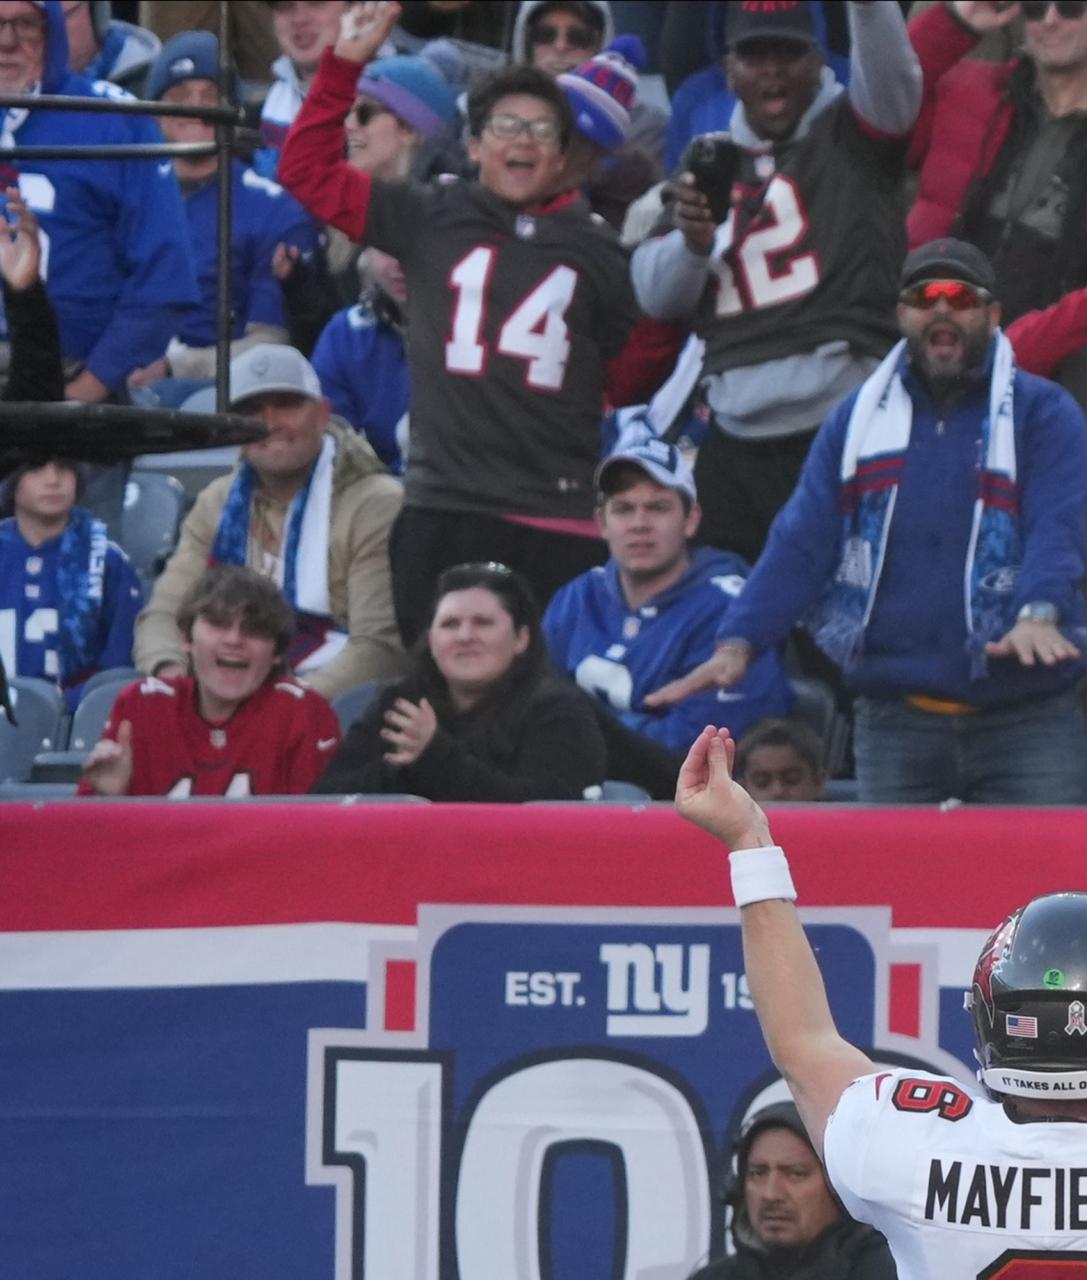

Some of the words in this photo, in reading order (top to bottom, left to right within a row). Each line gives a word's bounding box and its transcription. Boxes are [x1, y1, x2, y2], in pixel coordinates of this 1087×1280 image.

[446, 245, 578, 391] 14
[505, 971, 585, 1006] EST.
[1002, 1076, 1011, 1087] IT
[1013, 1078, 1049, 1091] TAKES
[1053, 1080, 1075, 1090] ALL
